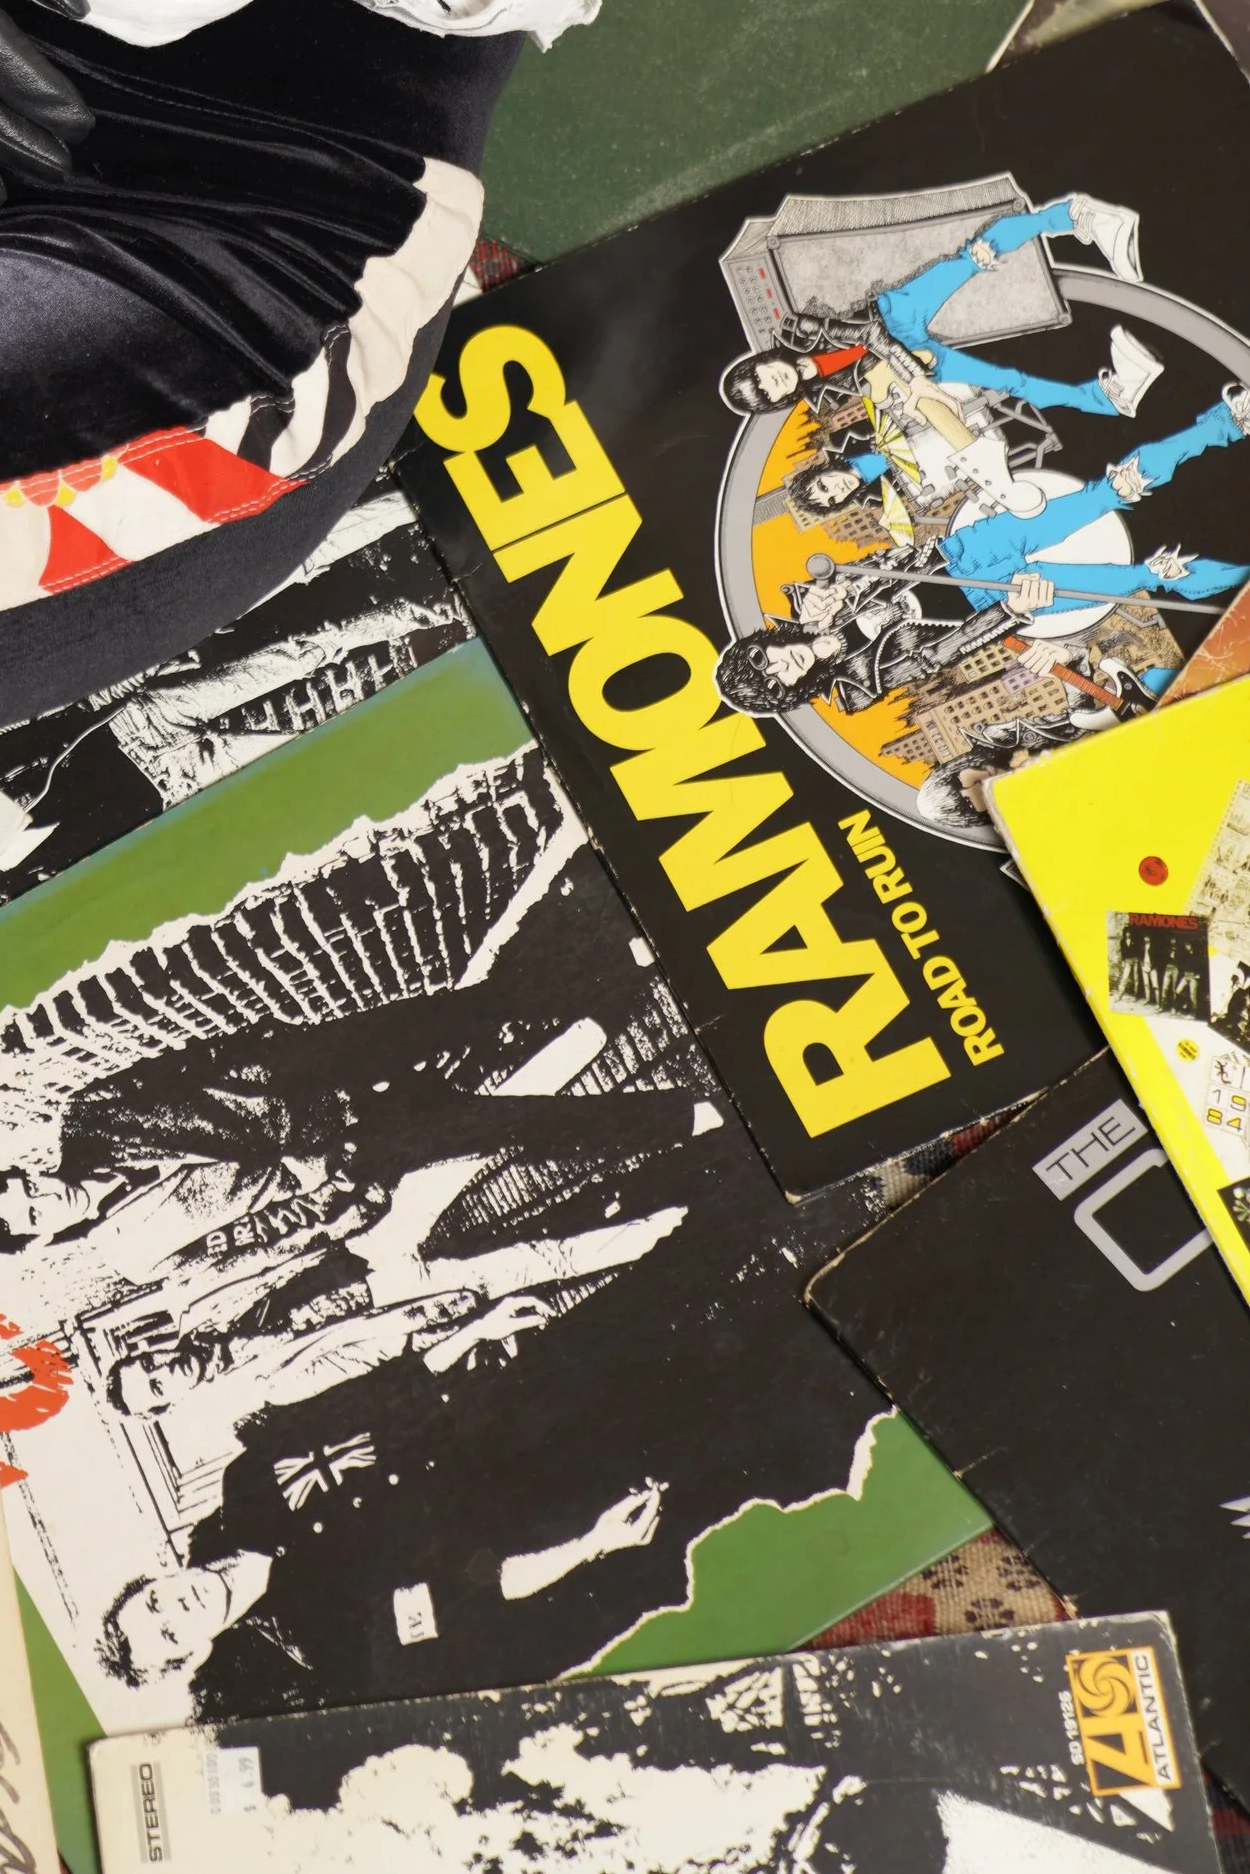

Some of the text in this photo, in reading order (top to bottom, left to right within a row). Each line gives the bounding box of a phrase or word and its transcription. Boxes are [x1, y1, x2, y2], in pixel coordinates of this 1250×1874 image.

[415, 324, 950, 1138] RAMONES
[837, 815, 1003, 1066] ROAD TO RUIN
[1129, 913, 1198, 930] RAMONES
[1046, 1117, 1135, 1180] THE
[1135, 1654, 1172, 1782] ATLANTIC
[138, 1763, 163, 1862] STEREO
